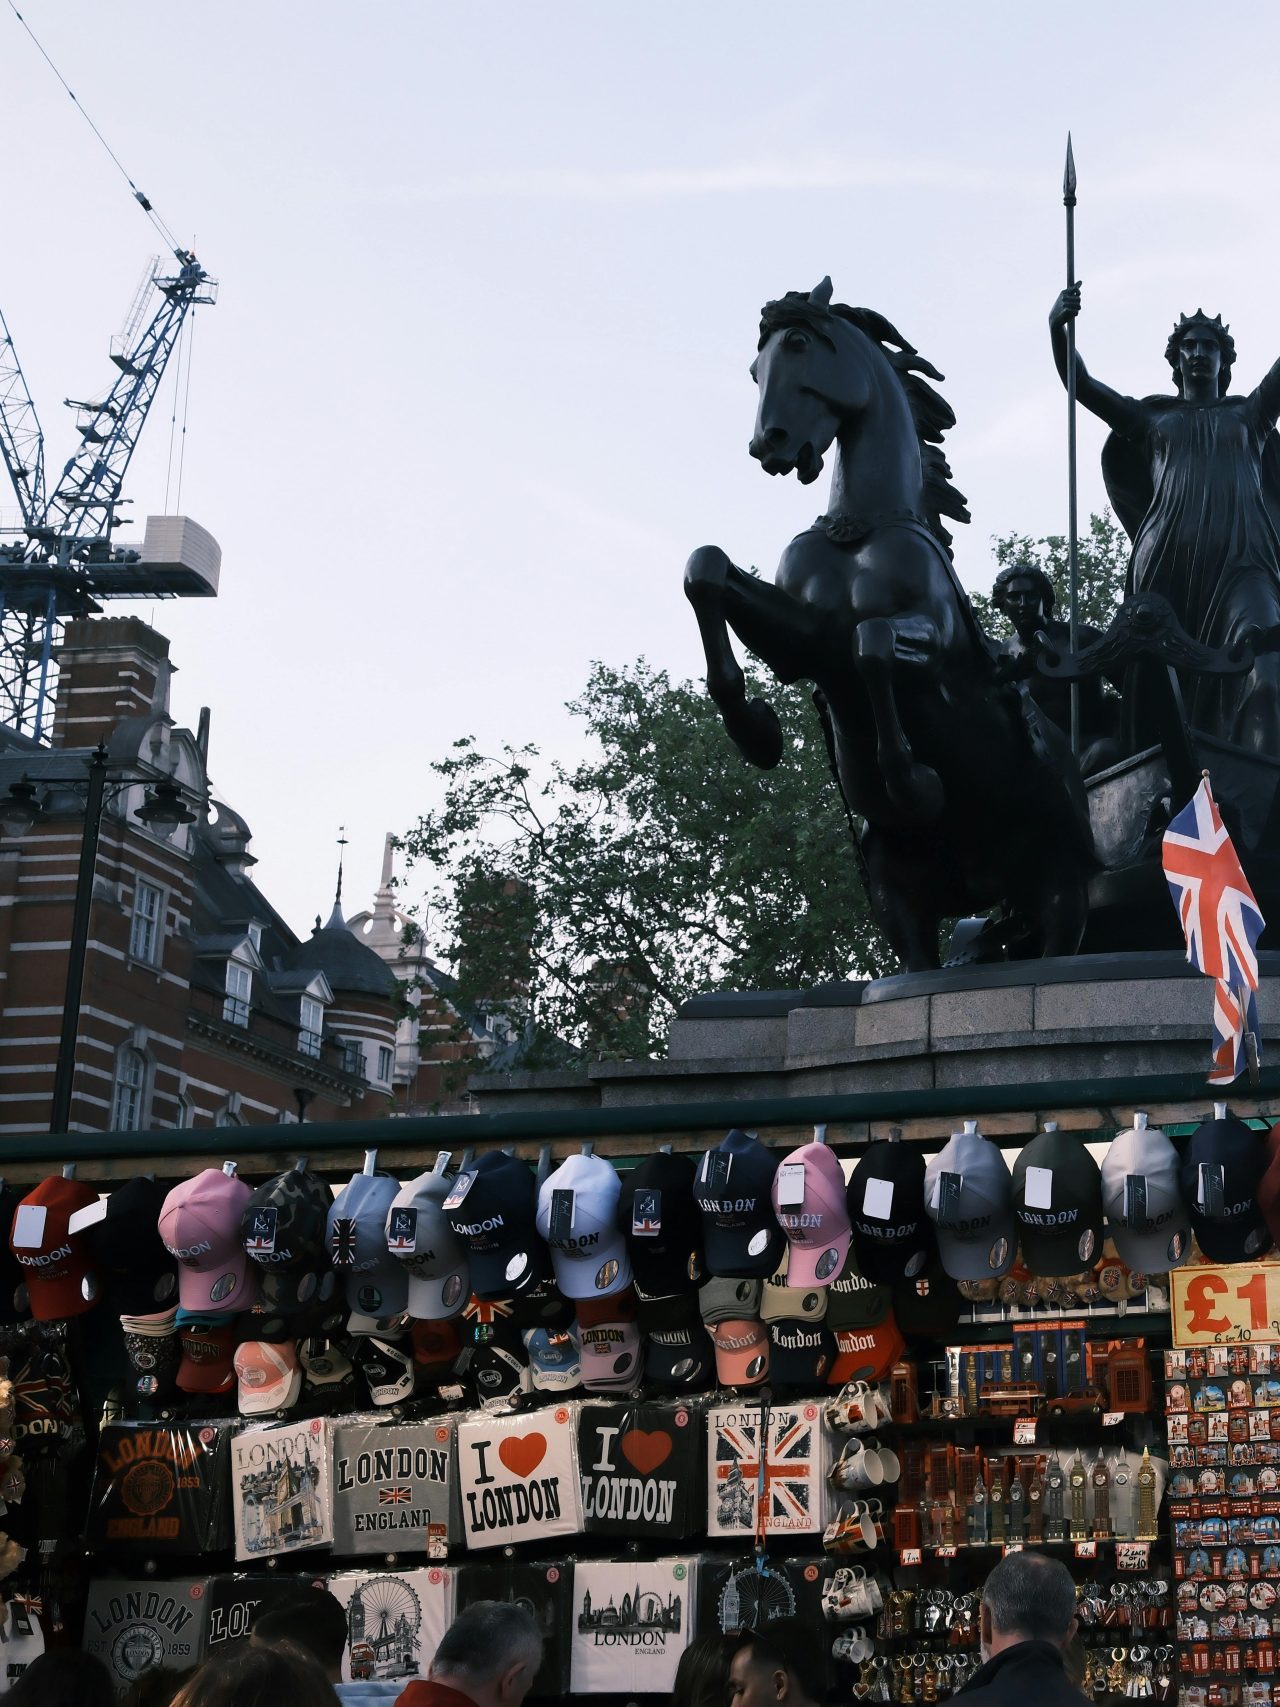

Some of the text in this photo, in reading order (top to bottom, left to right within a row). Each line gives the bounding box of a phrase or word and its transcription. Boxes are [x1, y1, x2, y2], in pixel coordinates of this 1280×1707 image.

[451, 1214, 505, 1236] LONDON
[776, 1214, 823, 1229] ONDON
[1017, 1208, 1079, 1226] LONDON
[855, 1220, 919, 1240] LONDON
[16, 1243, 74, 1268] LONDON
[581, 1329, 625, 1345] LONDON
[771, 1325, 822, 1350] London
[1237, 1329, 1252, 1342] 10
[236, 1426, 320, 1470] LONDON
[592, 1426, 620, 1472] I
[337, 1446, 449, 1494] LONDON
[471, 1440, 495, 1485] I
[467, 1476, 561, 1533] LONDON
[581, 1475, 678, 1523] LONDON
[354, 1508, 432, 1533] ENGLAND
[90, 1591, 195, 1636] LONDON
[209, 1600, 263, 1645] LON
[168, 1643, 192, 1656] 1859
[593, 1631, 667, 1646] LONDON
